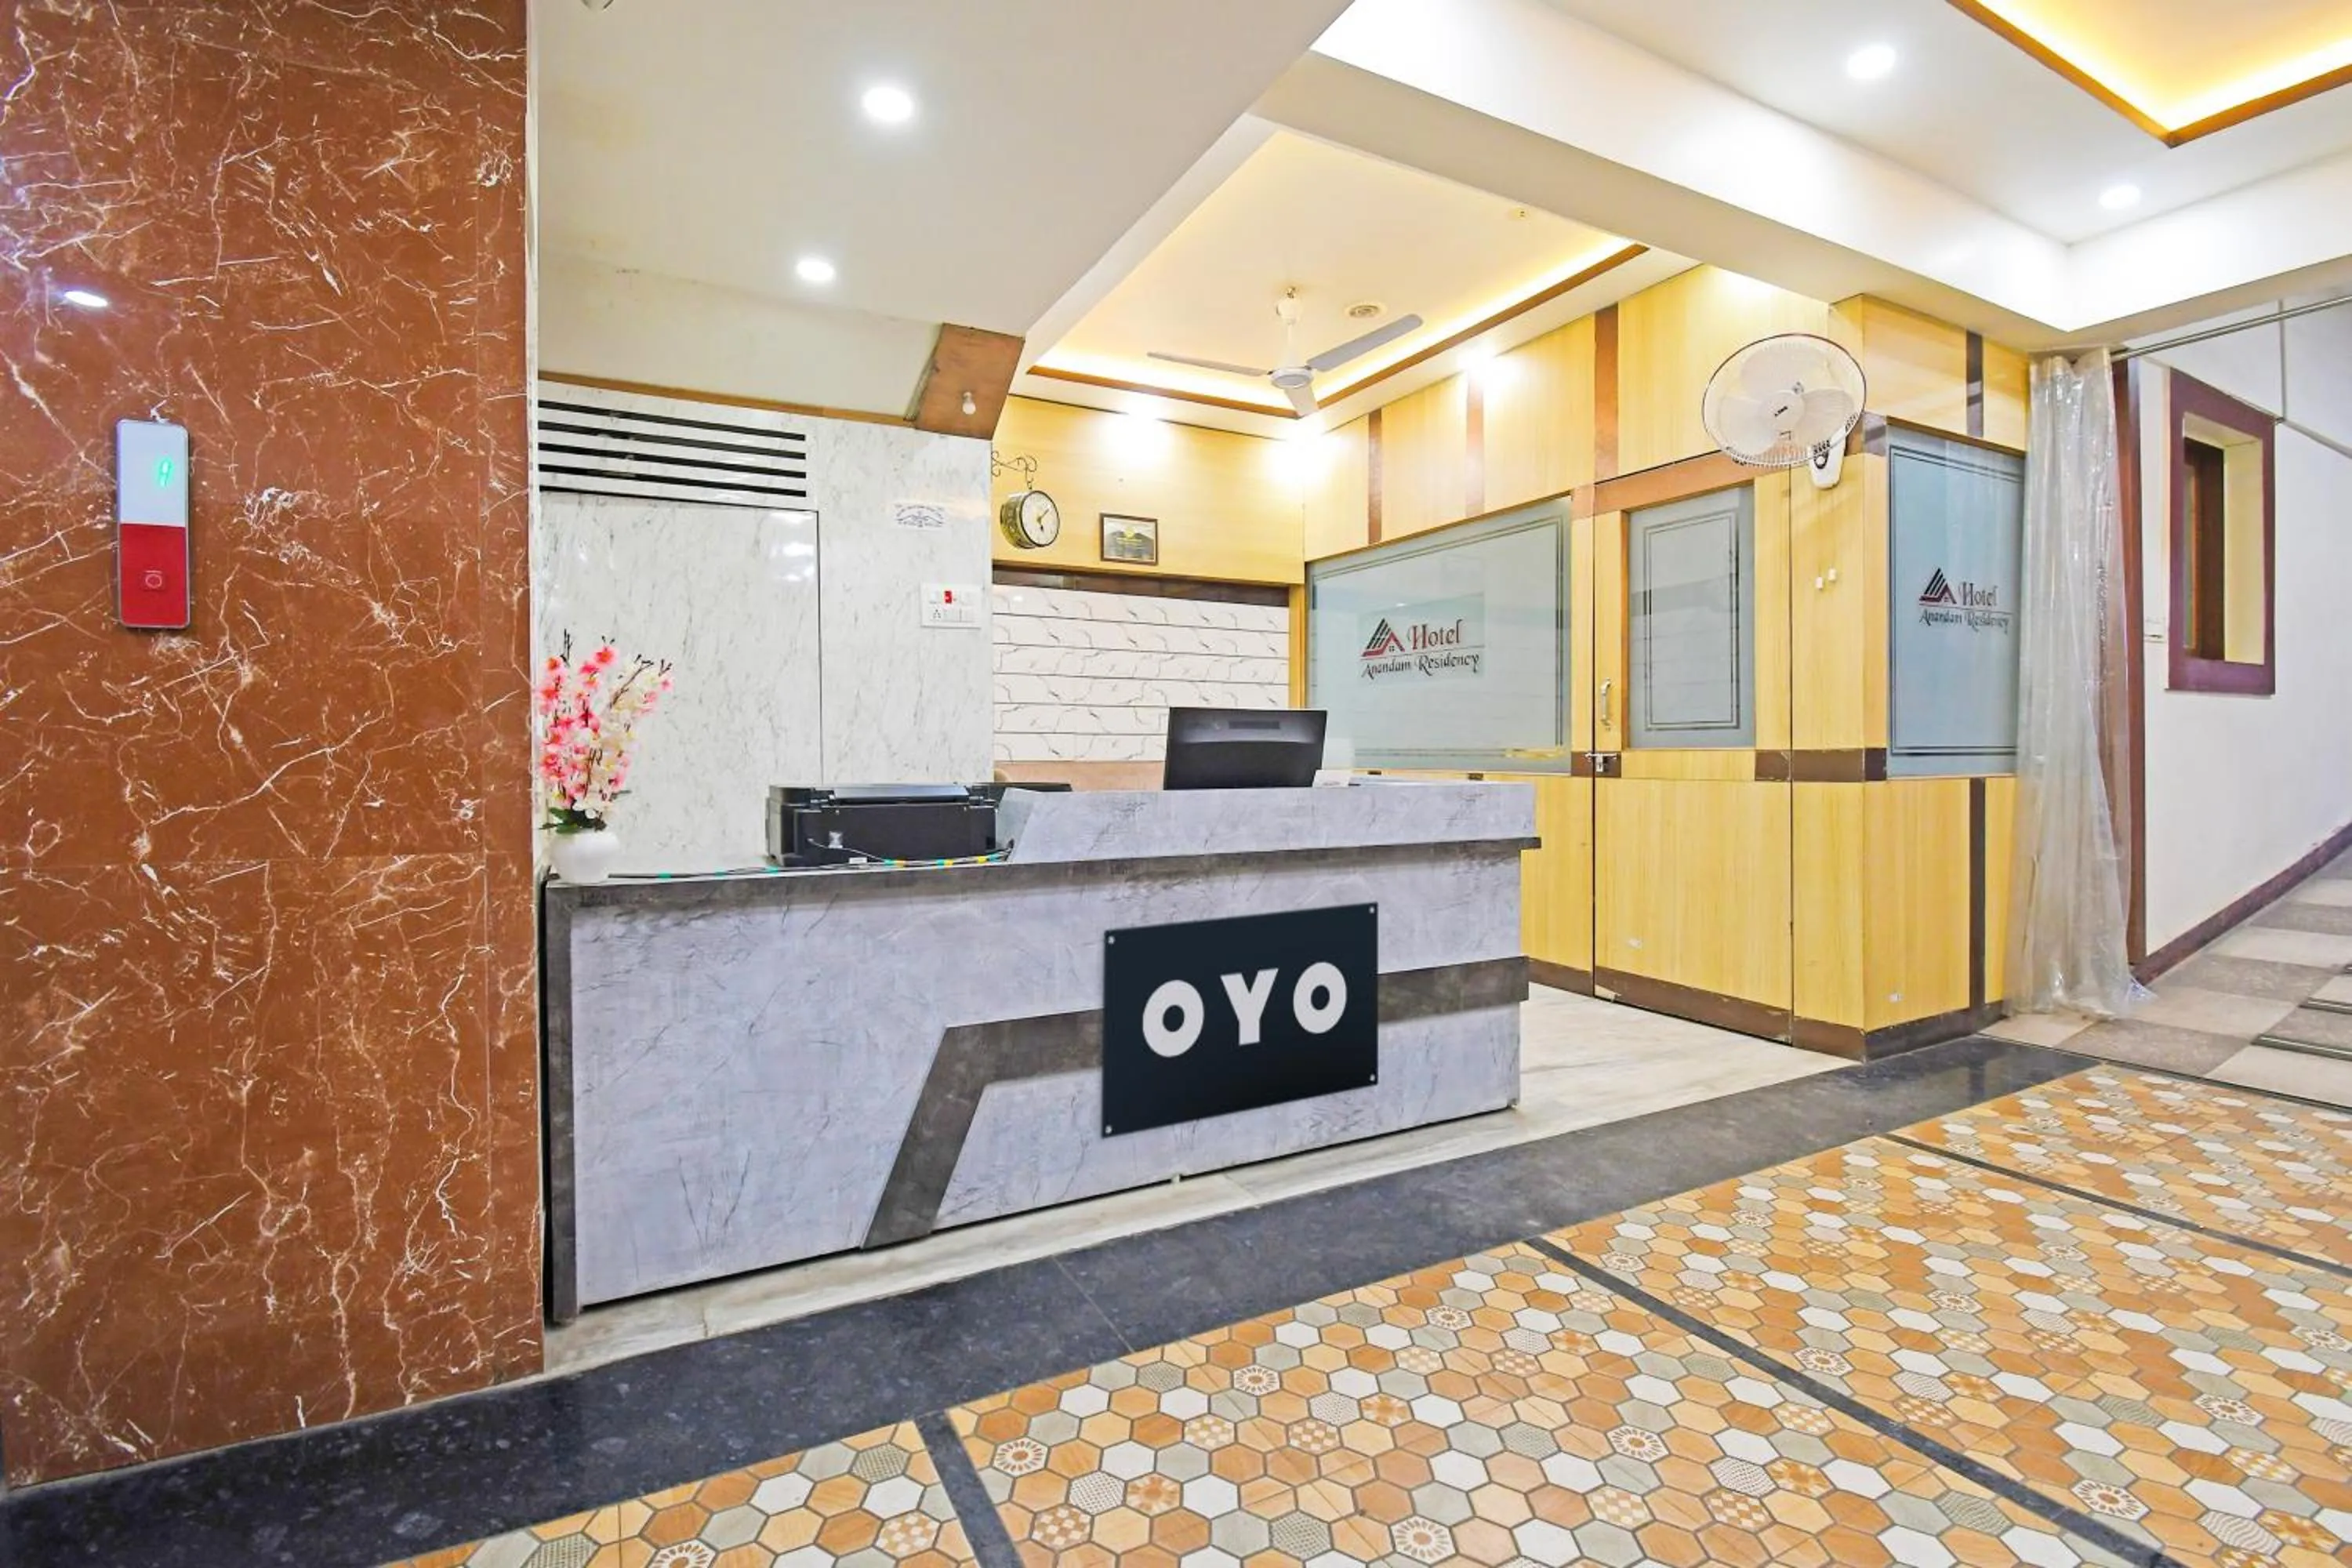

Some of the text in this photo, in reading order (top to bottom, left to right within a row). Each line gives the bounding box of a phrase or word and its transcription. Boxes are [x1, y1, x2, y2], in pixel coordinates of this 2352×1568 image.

[1958, 582, 1998, 606] Hotel
[1407, 619, 1464, 650] Hotel
[1361, 652, 1480, 680] Anandam Residency
[1142, 961, 1348, 1058] OYO
